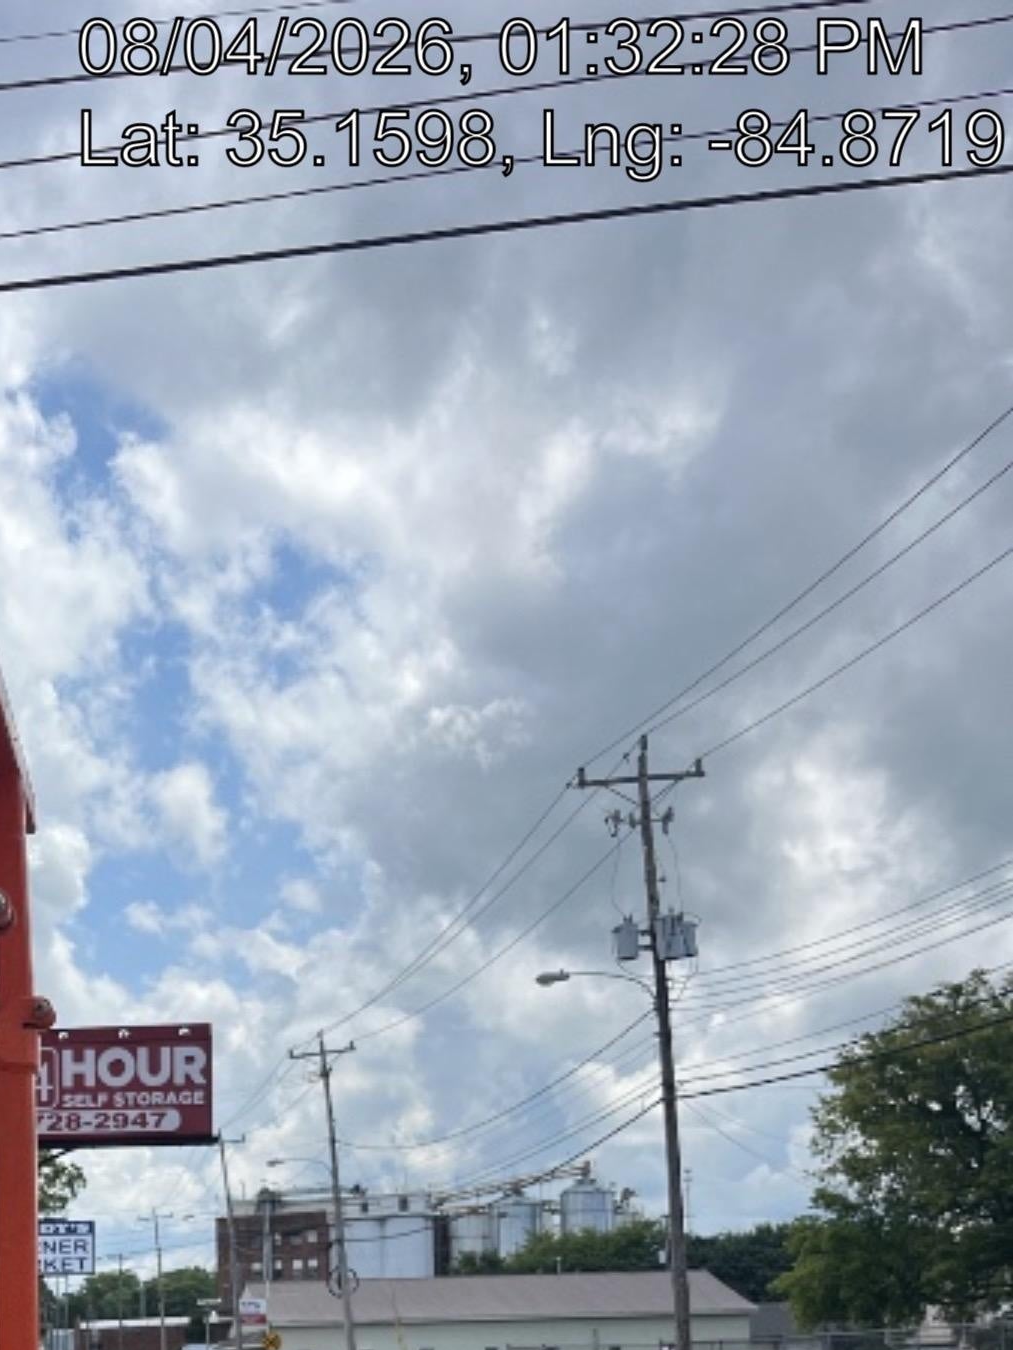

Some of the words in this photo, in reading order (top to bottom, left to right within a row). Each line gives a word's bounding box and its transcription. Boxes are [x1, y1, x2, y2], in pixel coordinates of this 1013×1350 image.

[61, 1046, 207, 1088] HOUR
[61, 1092, 109, 1109] SELF
[113, 1090, 205, 1107] STORAGE
[38, 1238, 89, 1255] NER
[38, 1256, 88, 1273] KET
